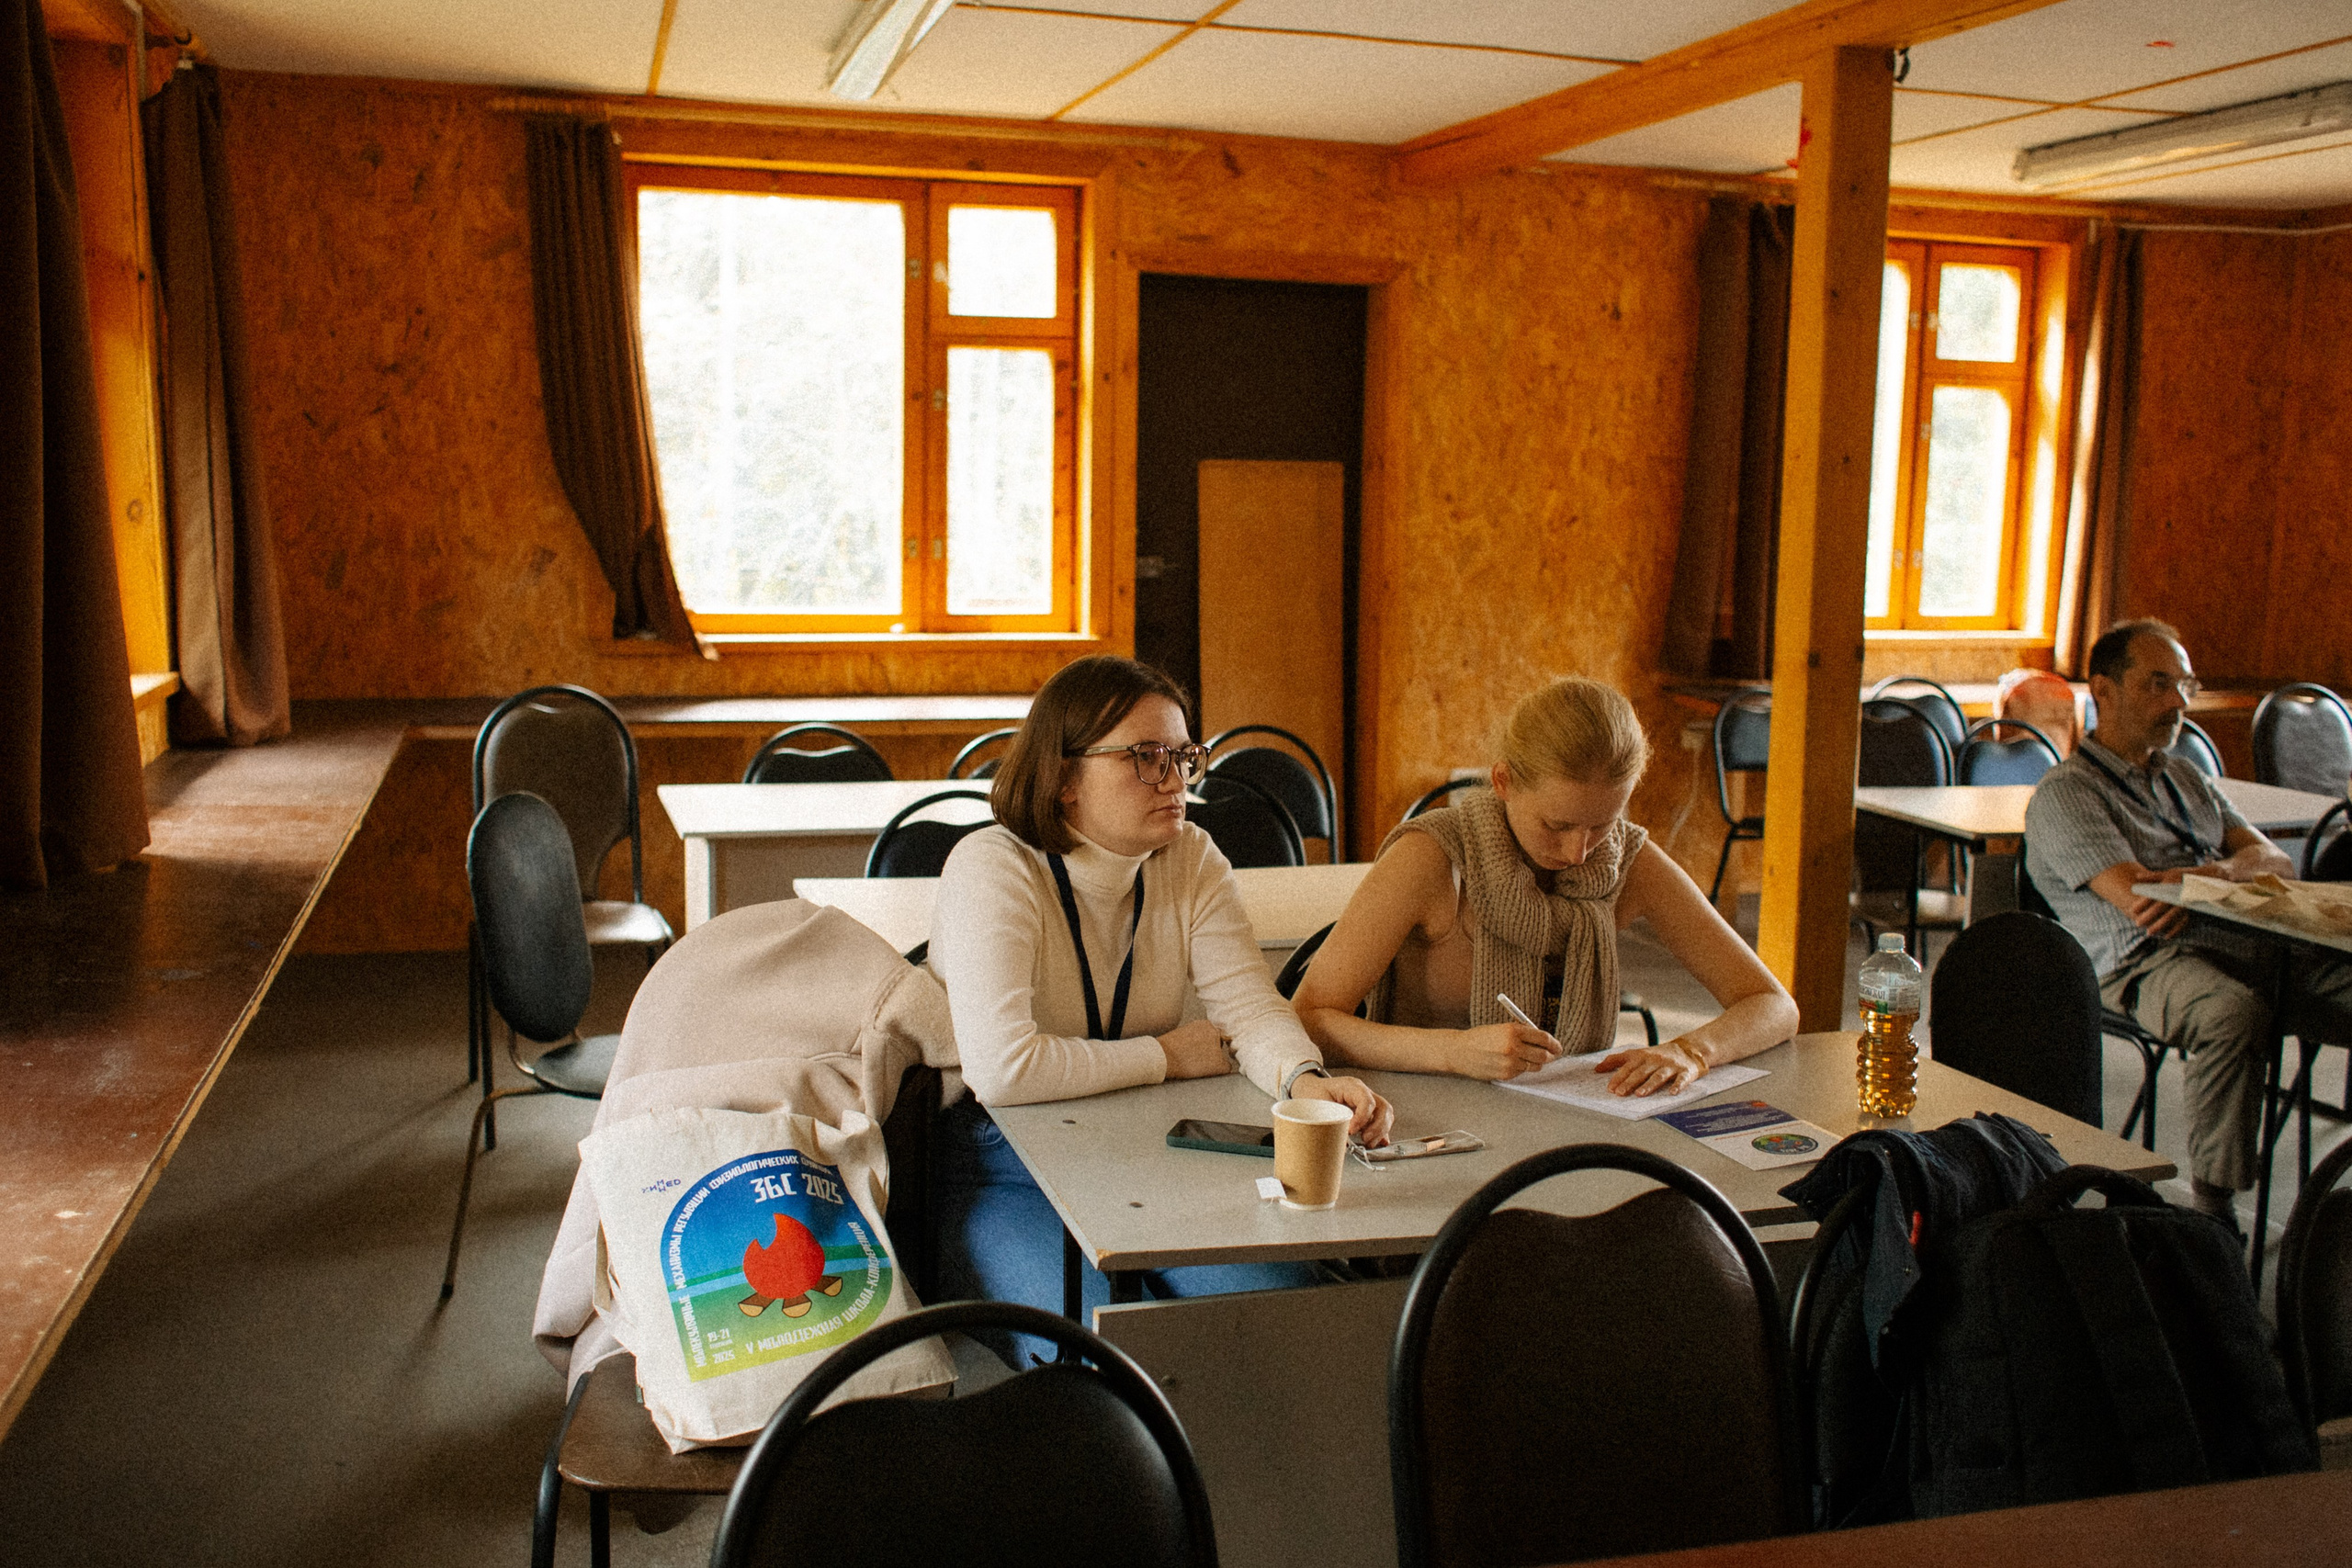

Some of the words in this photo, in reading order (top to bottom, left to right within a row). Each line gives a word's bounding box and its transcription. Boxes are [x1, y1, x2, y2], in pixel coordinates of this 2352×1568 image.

[708, 1155, 798, 1190] ФИЗИОЛОГИЧЕСКИХ
[750, 1173, 797, 1203] ЗБС
[801, 1173, 844, 1204] 2025
[673, 1187, 710, 1233] РЕГУЛЯЦИИ
[669, 1235, 687, 1290] МЕХАНИЗМЫ
[707, 1327, 729, 1342] 19-21
[745, 1341, 753, 1354] V
[757, 1315, 844, 1352] МОЛОДЕЖНАЯ
[712, 1349, 735, 1364] 2025
